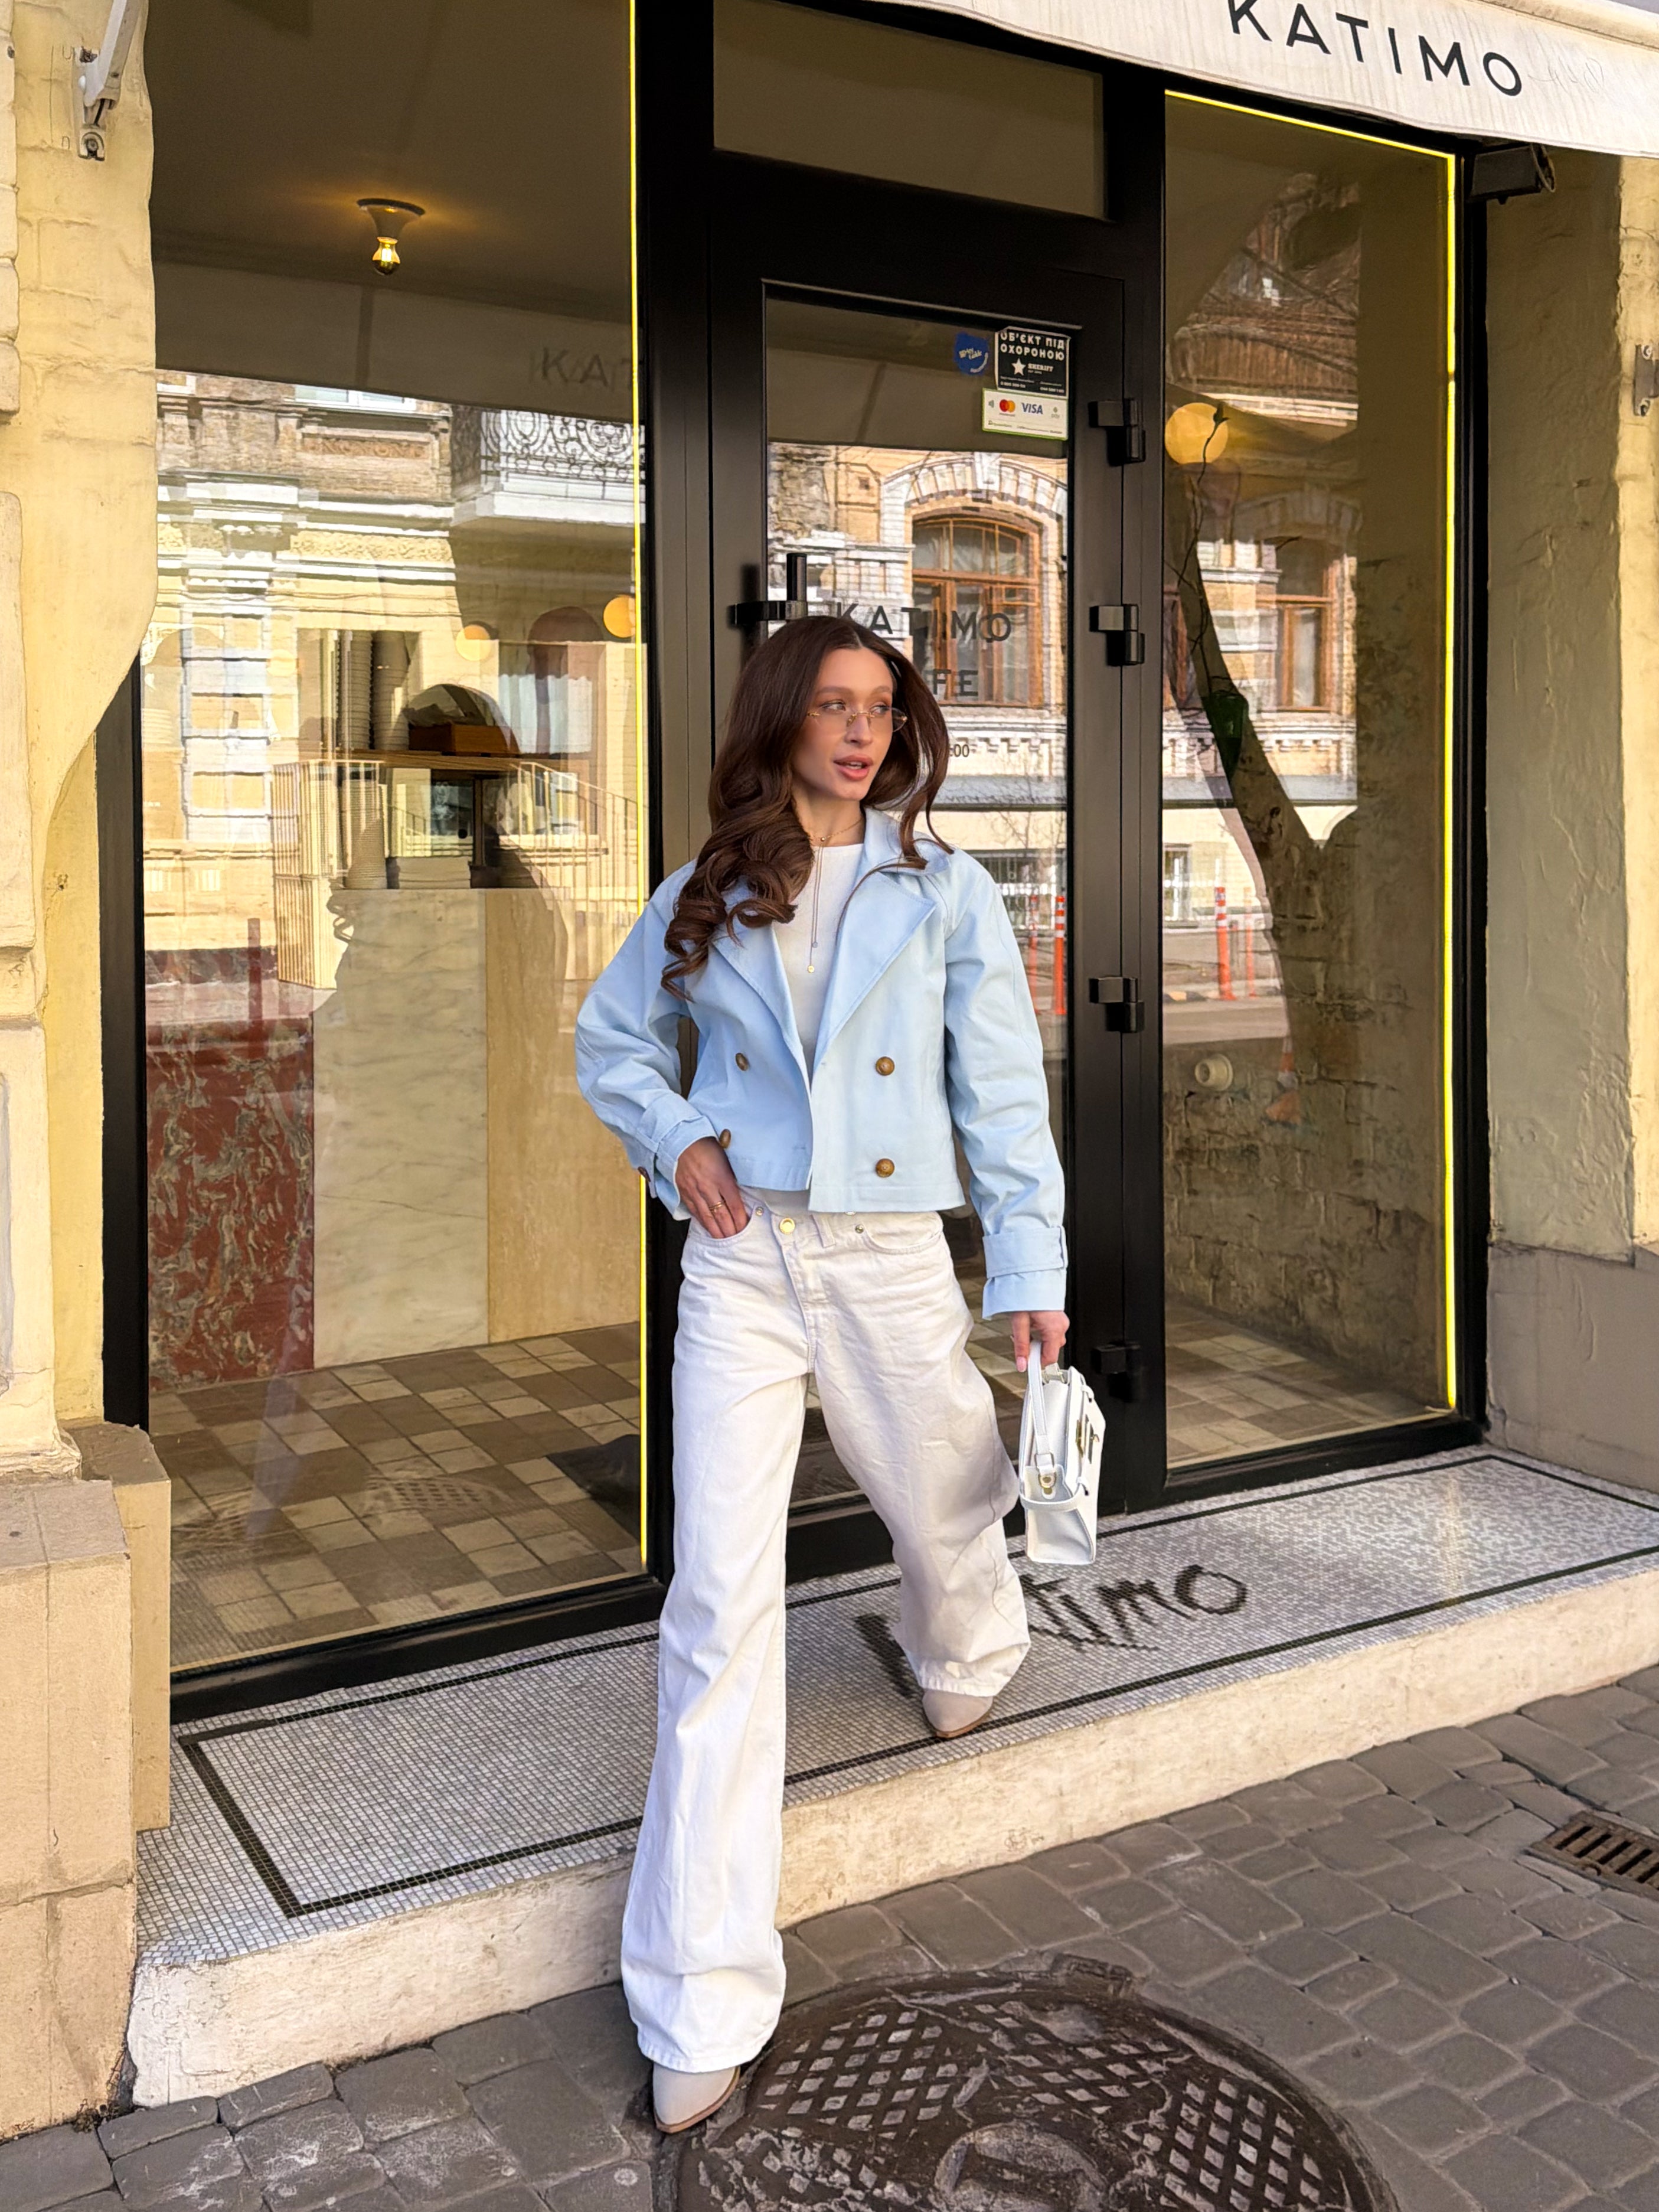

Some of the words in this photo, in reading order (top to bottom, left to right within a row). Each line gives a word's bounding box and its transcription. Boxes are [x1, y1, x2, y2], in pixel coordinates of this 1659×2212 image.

[1227, 0, 1522, 96] KATIMO
[1000, 332, 1041, 345] ОБ'ЄКТ
[1046, 337, 1064, 350] ПІД
[1000, 343, 1064, 361] ОХОРОНОЮ
[1021, 402, 1043, 415] VISA
[933, 668, 978, 696] FE
[950, 744, 969, 758] :00
